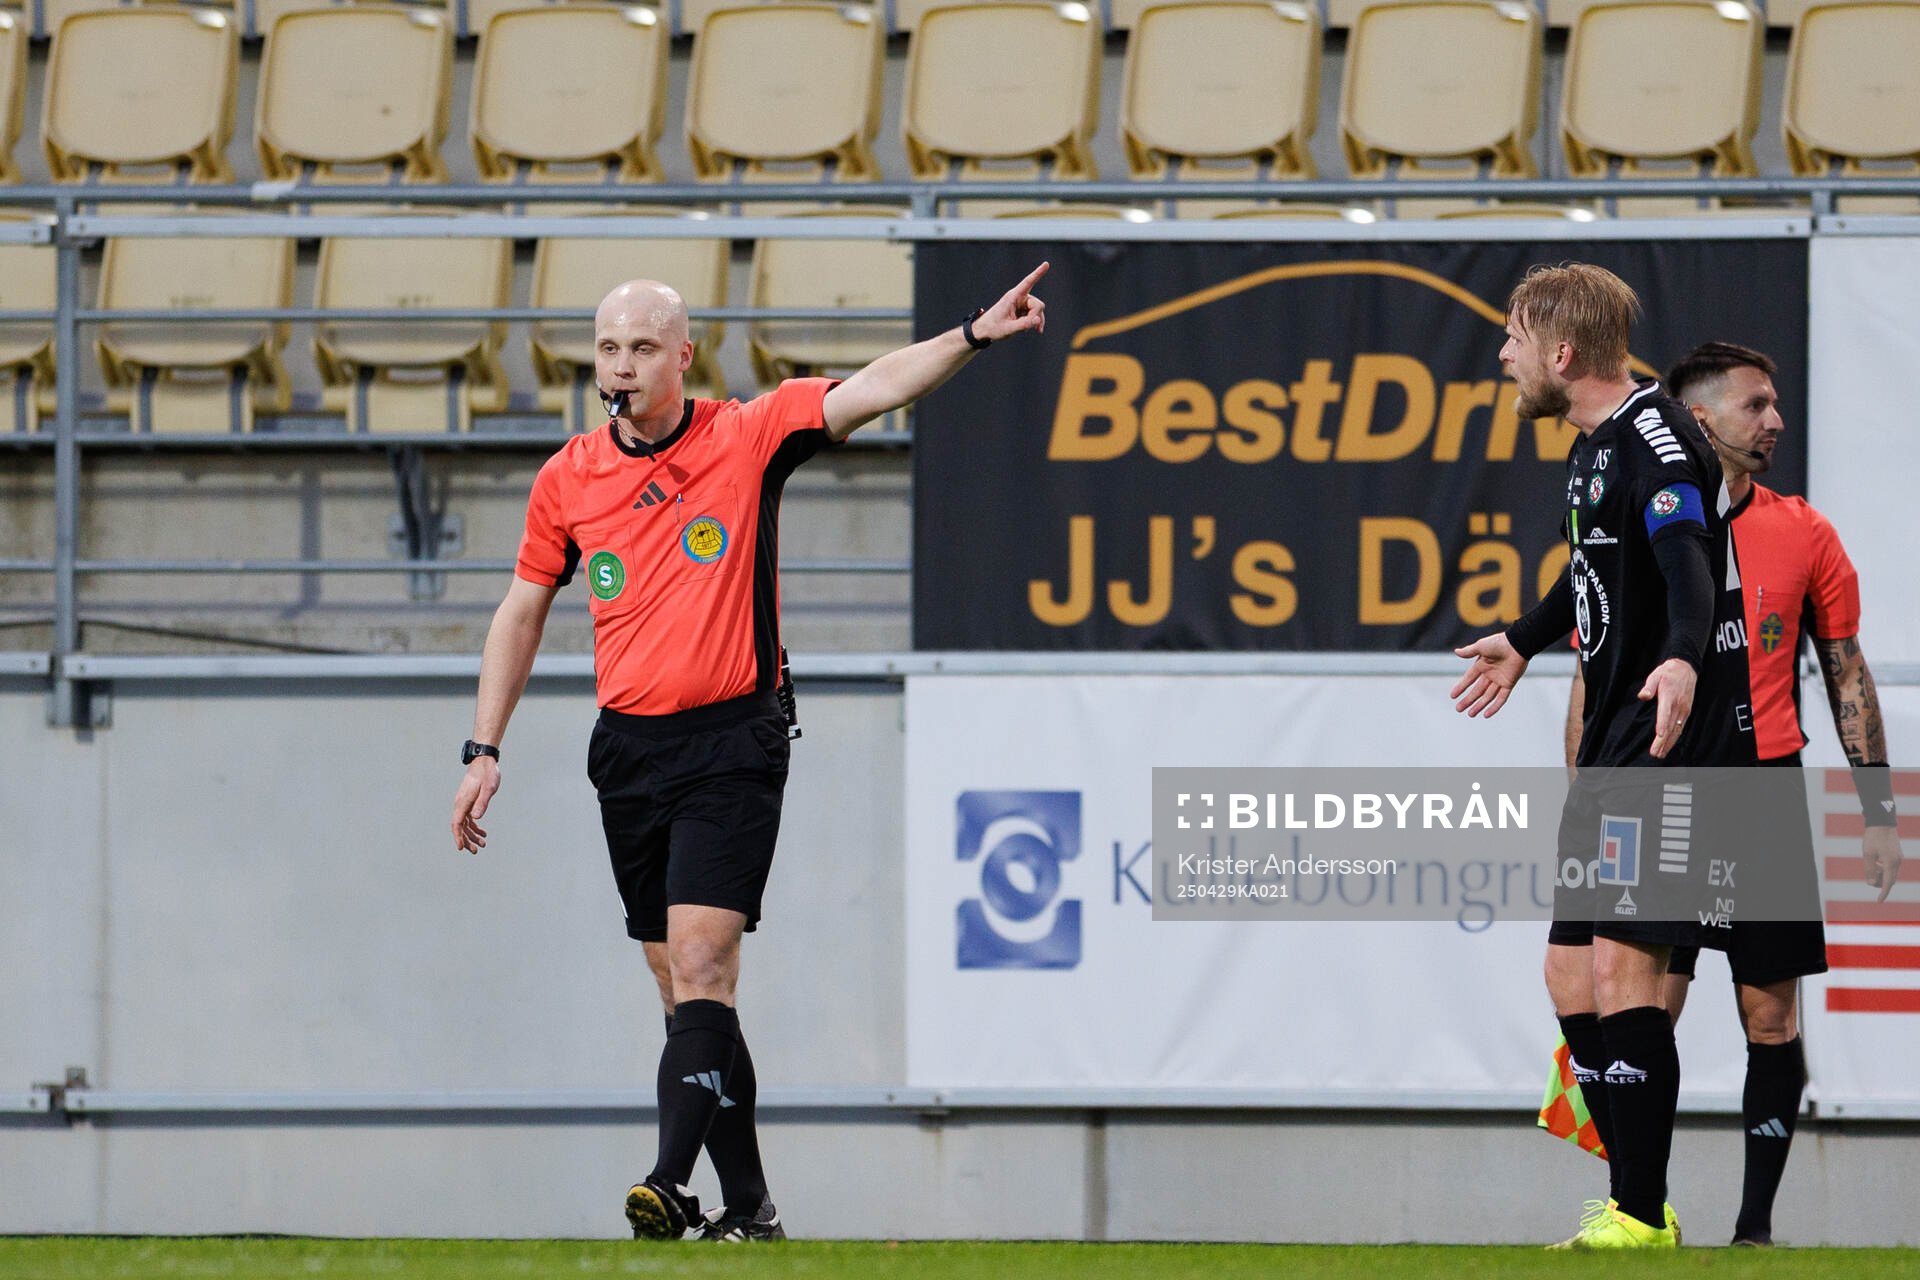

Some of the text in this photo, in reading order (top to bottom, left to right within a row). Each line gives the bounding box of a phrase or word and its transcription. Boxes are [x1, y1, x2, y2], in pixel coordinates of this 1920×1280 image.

[599, 565, 613, 587] S
[1029, 516, 1297, 627] JJ's
[1587, 567, 1610, 625] PASSION
